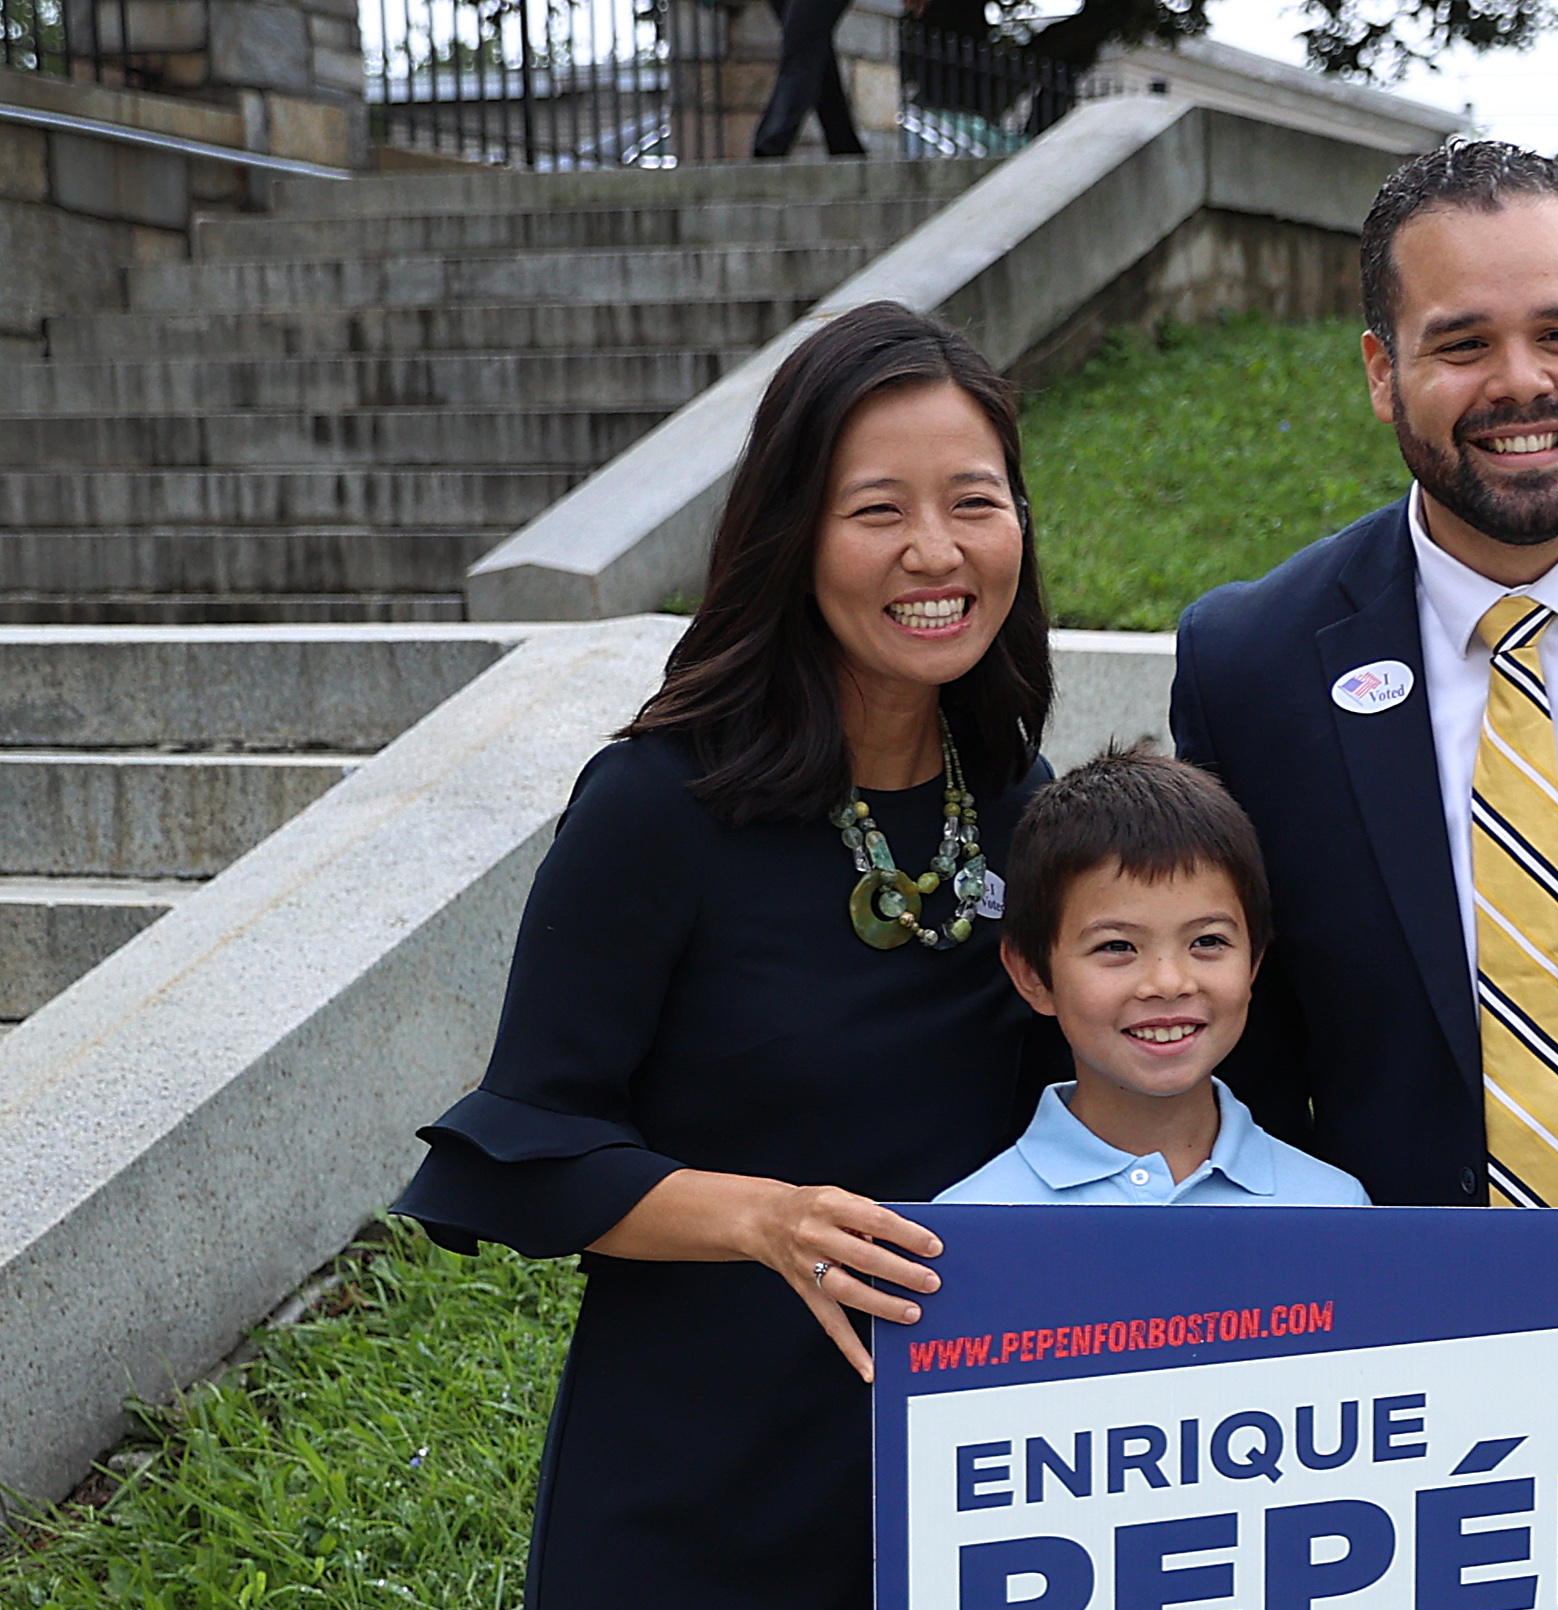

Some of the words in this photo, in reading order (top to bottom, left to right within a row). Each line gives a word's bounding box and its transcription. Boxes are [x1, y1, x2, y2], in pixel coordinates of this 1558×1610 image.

[1369, 684, 1405, 702] Voted
[1384, 673, 1389, 685] I
[909, 1301, 1333, 1373] WWW.PEPENFORBOSTON.COM
[956, 1392, 1428, 1513] ENRIQUE
